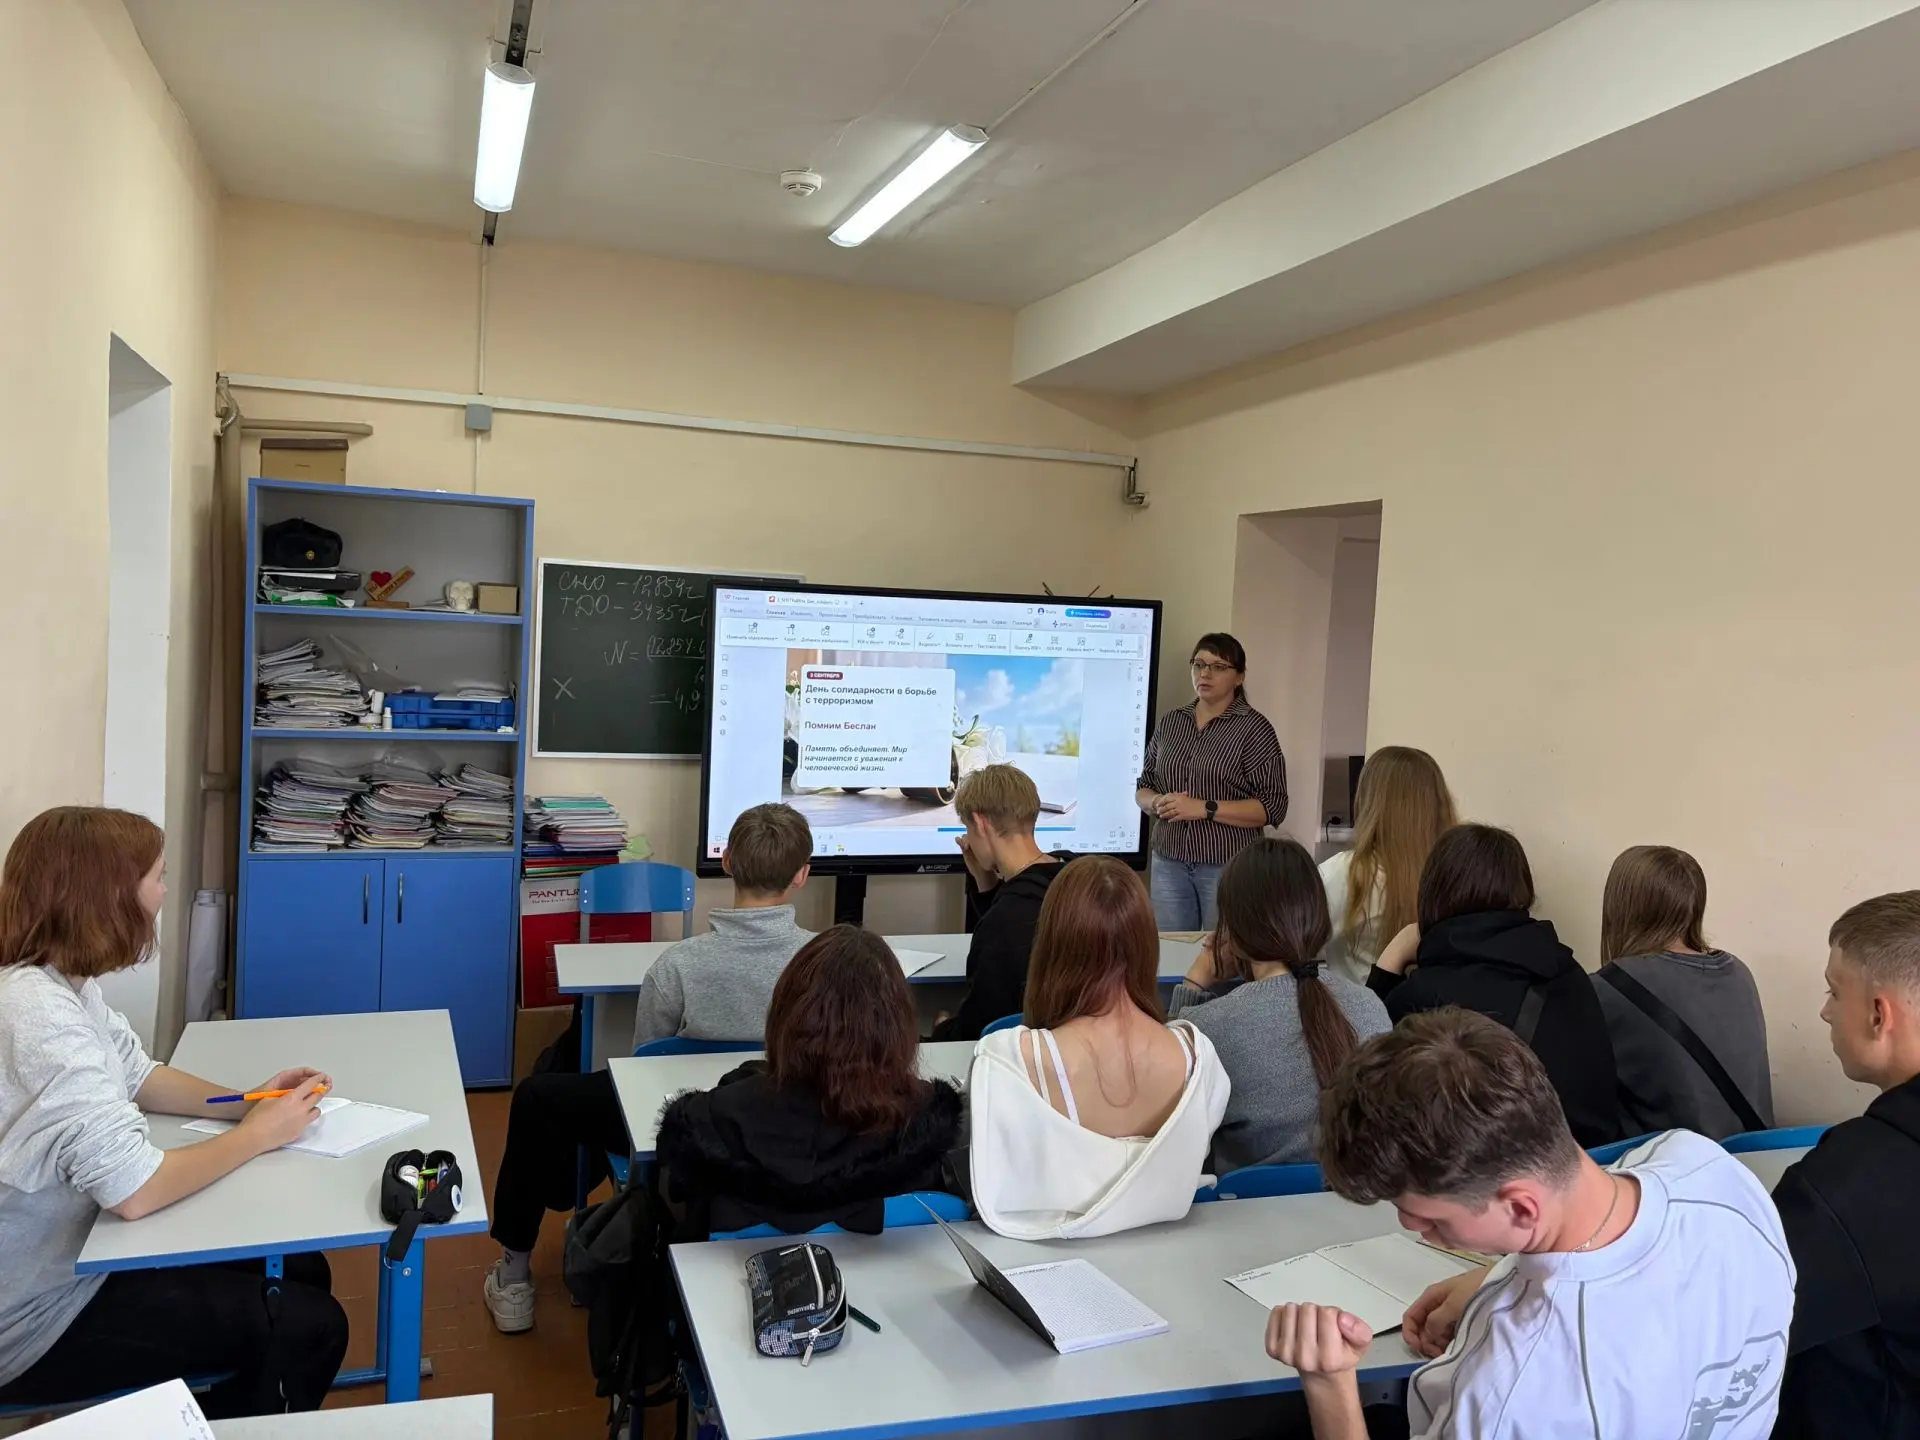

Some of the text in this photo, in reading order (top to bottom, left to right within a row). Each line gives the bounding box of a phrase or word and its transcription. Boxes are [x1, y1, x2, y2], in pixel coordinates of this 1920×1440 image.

[805, 684, 829, 694] День
[831, 685, 895, 696] солидарности
[904, 687, 937, 697] борьбе
[813, 698, 874, 706] терроризмом
[804, 721, 877, 730] Помним Беслан
[805, 744, 908, 754] Память объединяет. Мир
[804, 755, 853, 763] начинается
[860, 755, 898, 764] уважения
[804, 764, 858, 772] человеческой
[529, 889, 580, 899] PANTU
